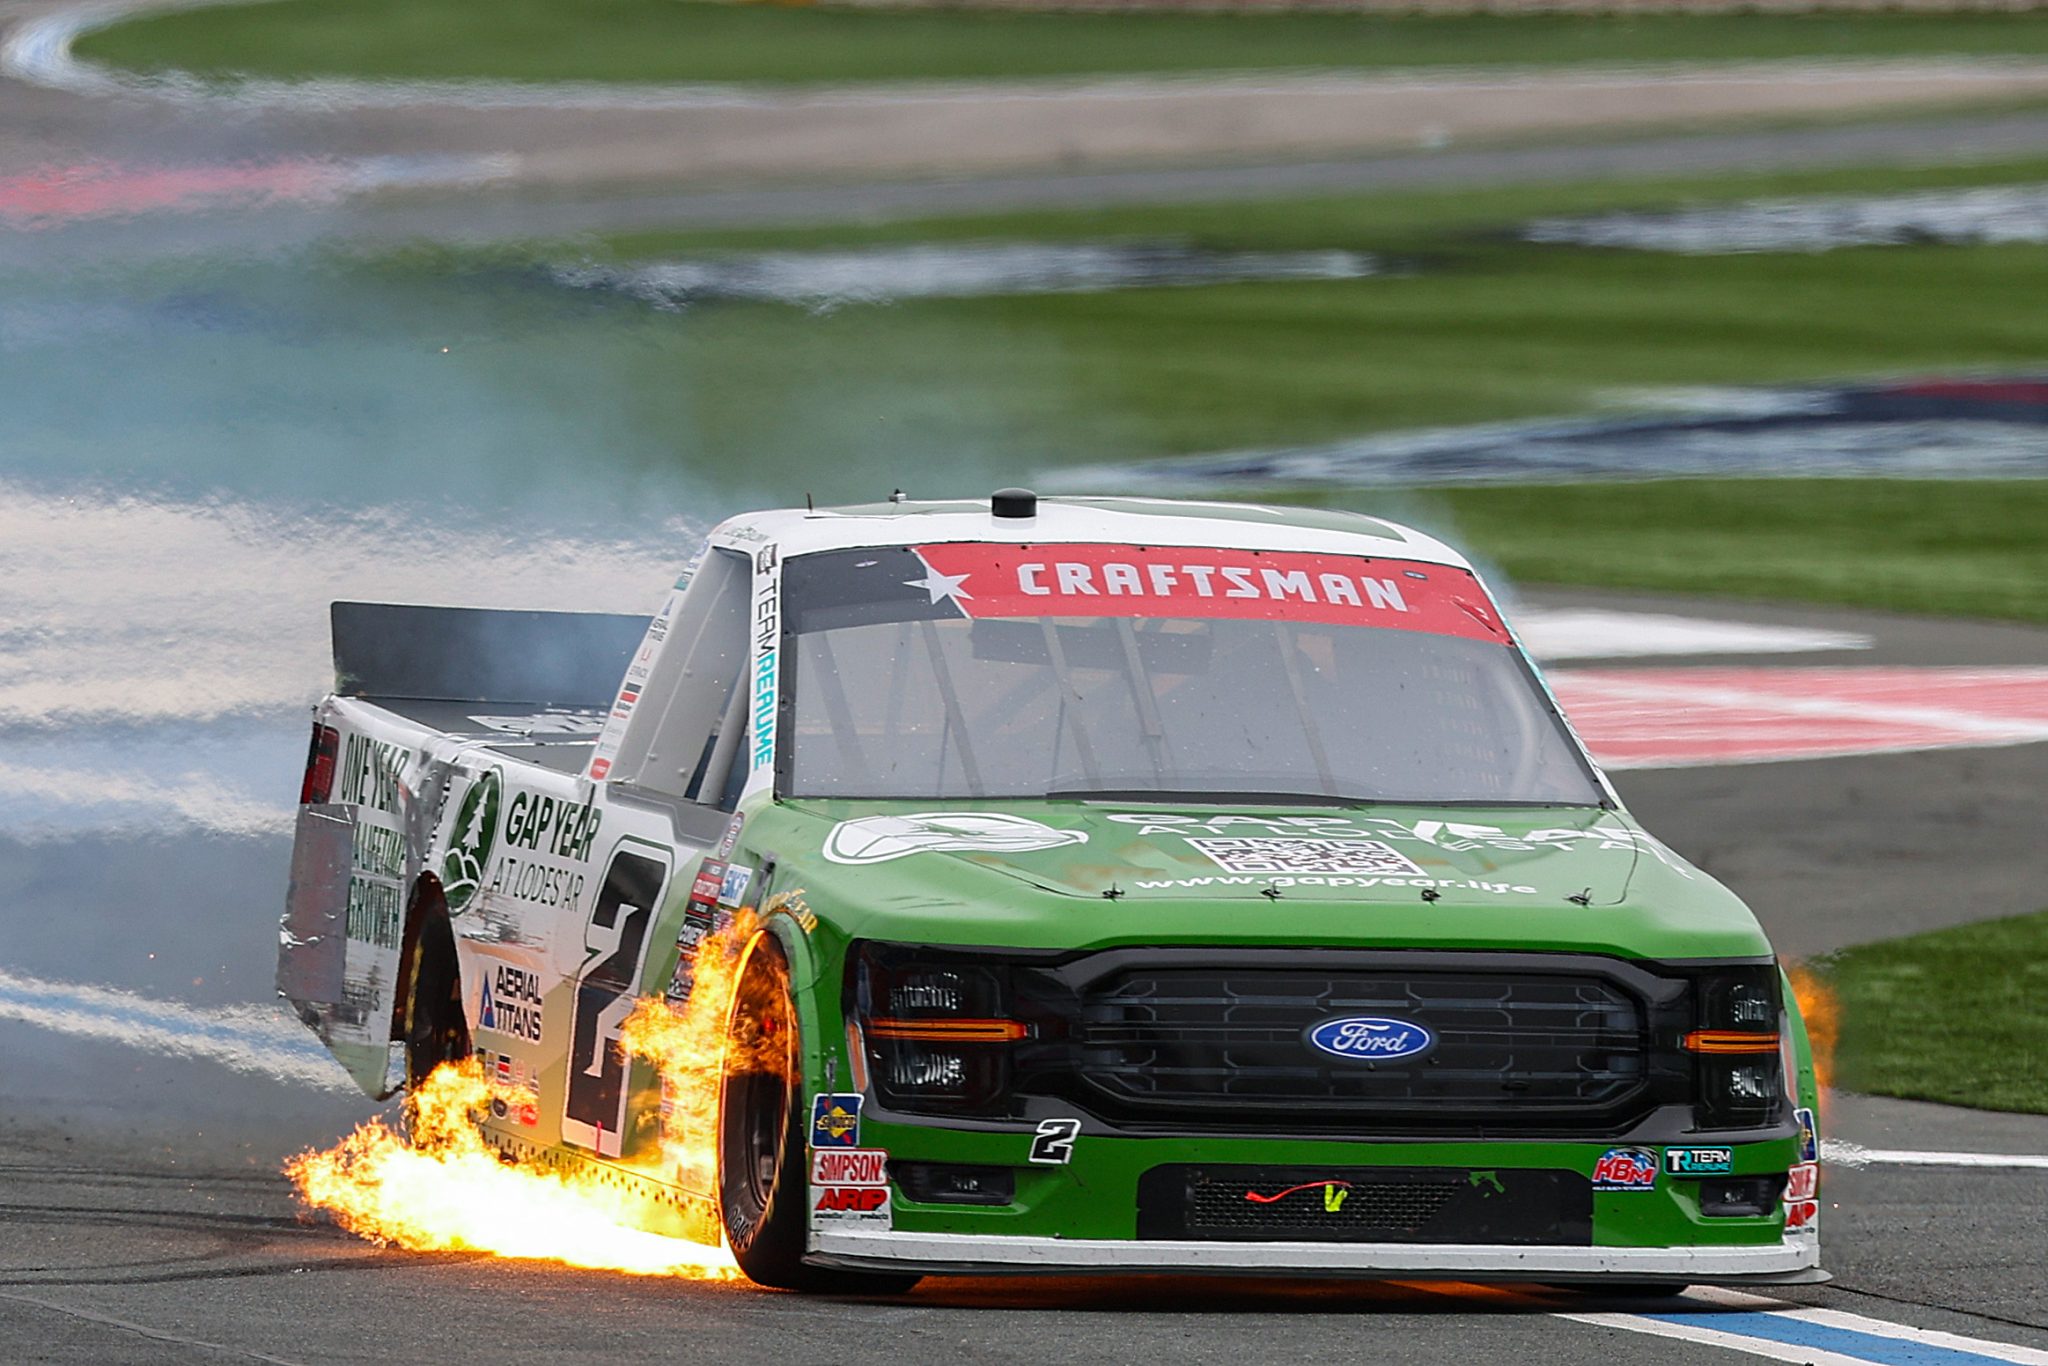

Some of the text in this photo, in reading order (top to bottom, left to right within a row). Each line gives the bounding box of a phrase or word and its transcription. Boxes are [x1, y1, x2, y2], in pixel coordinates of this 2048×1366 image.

[1018, 563, 1408, 612] CRAFTSMAN
[342, 733, 371, 806] ONE
[506, 791, 602, 863] GAP YEAR
[1107, 814, 1352, 827] GAP
[1138, 825, 1227, 835] AT
[491, 857, 584, 913] AT LODESTAR
[1136, 875, 1538, 893] www.gapyear.life
[495, 965, 543, 1006] AERIAL
[562, 840, 671, 1157] 2
[494, 1000, 543, 1041] TITANS
[1332, 1022, 1408, 1053] Ford
[1028, 1118, 1082, 1165] 2
[818, 1154, 882, 1181] SIMPSON
[1591, 1155, 1656, 1185] KBM
[815, 1187, 888, 1211] ARP
